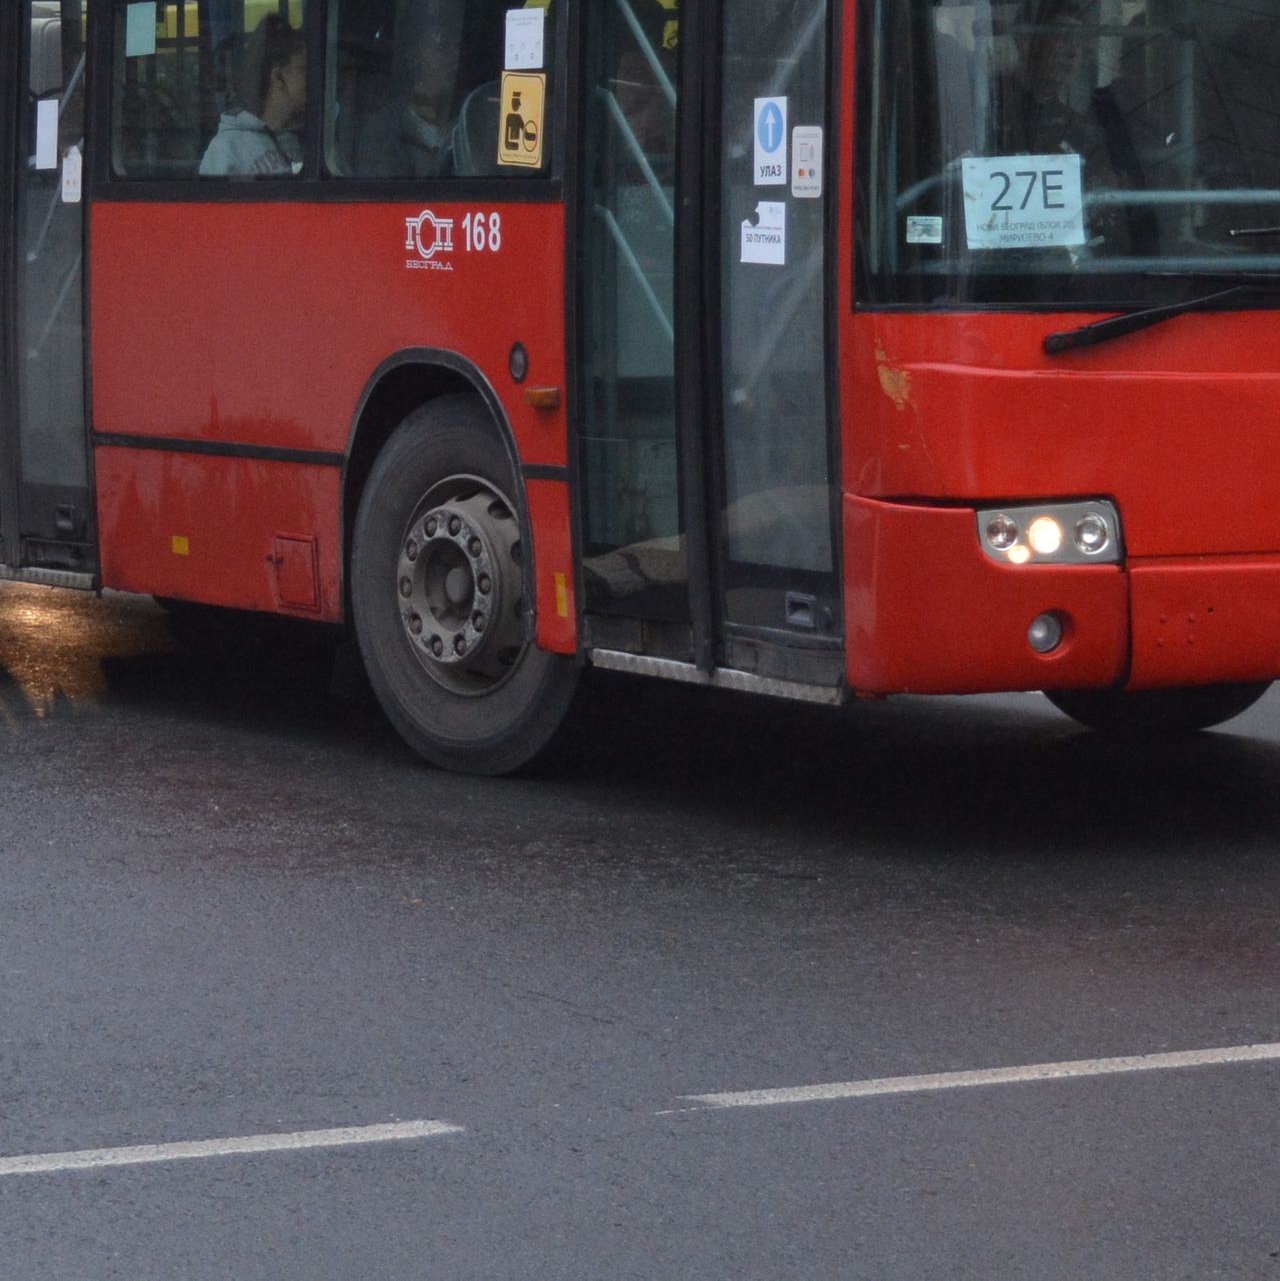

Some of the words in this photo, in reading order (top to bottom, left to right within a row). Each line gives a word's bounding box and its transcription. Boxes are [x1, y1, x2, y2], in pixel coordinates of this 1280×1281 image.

[760, 165, 782, 177] УЛАЗ
[990, 170, 1065, 211] 27E
[1001, 220, 1035, 231] БЕОГРАД
[462, 212, 501, 251] 168
[746, 233, 753, 243] 50
[754, 234, 781, 244] ПУТНИКА
[1000, 234, 1045, 243] МИРИЈЕВО
[405, 260, 454, 271] БЕОГРАД
